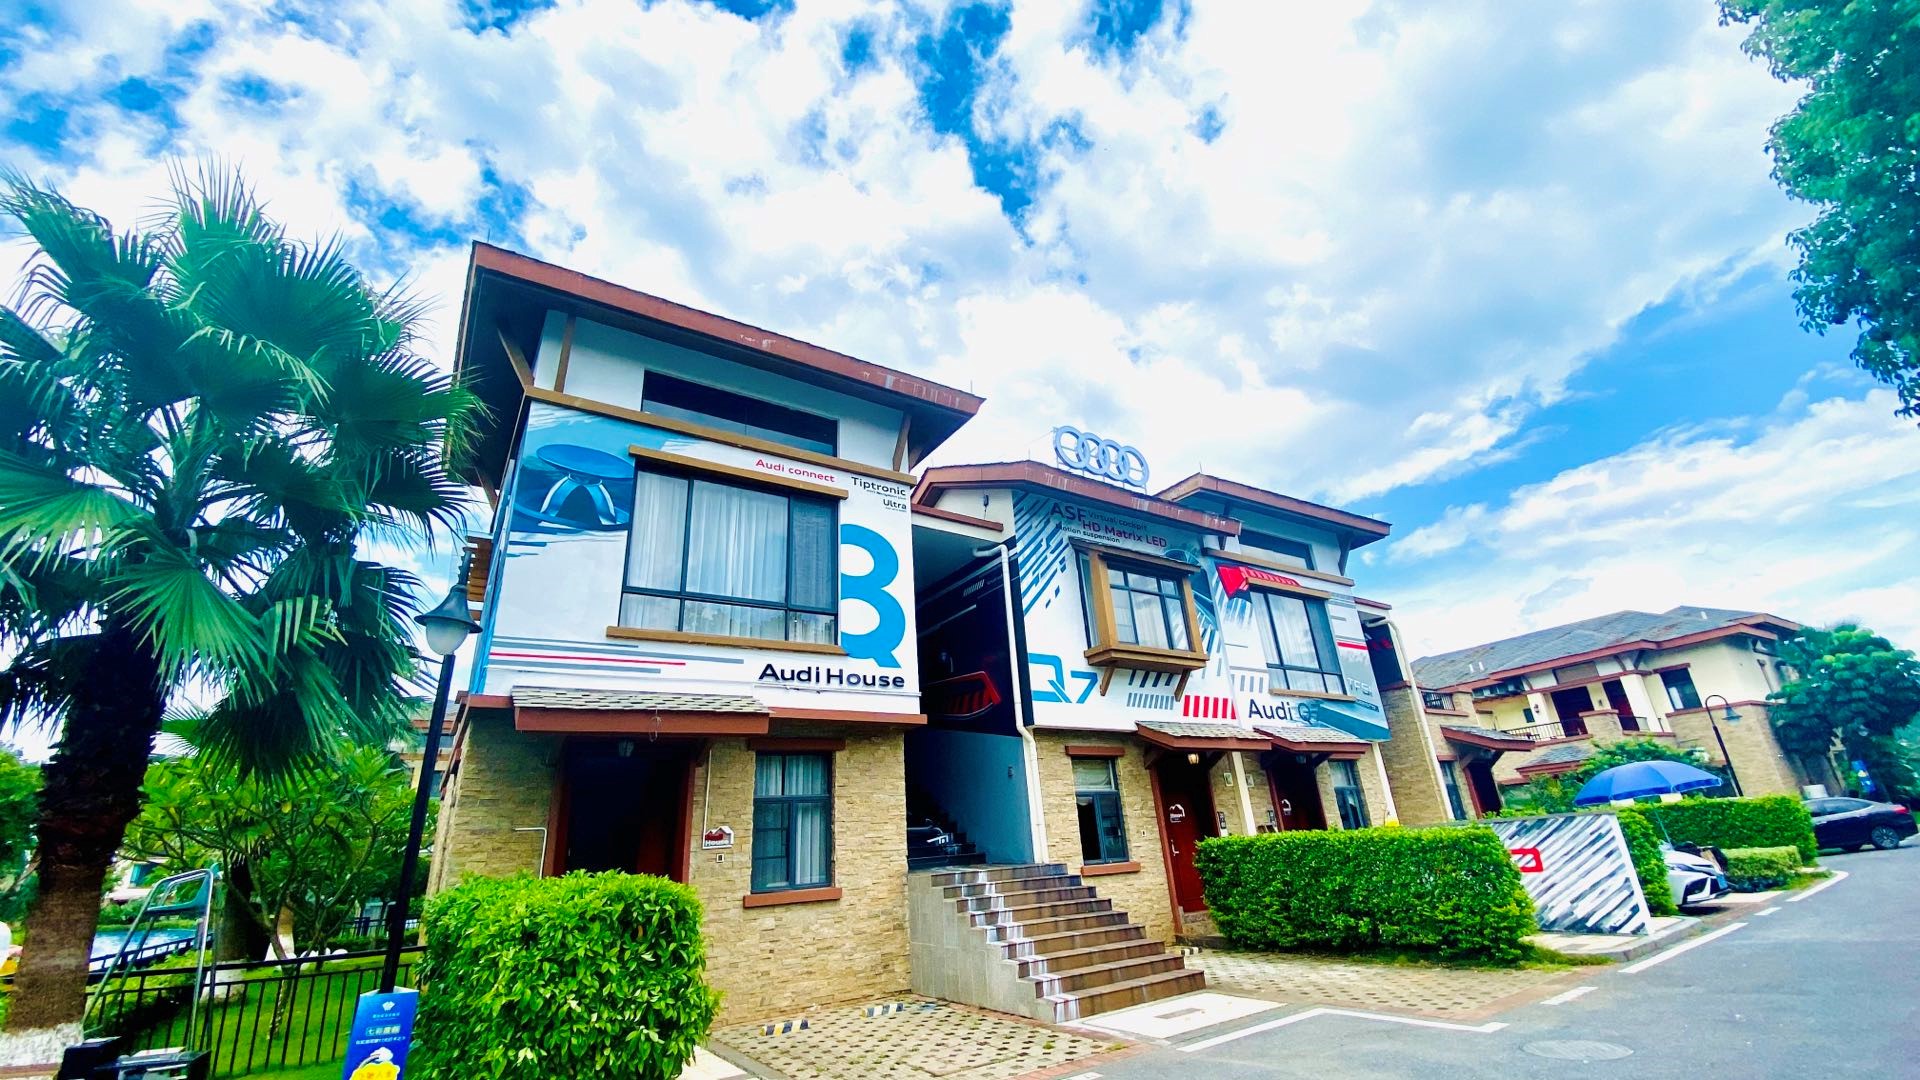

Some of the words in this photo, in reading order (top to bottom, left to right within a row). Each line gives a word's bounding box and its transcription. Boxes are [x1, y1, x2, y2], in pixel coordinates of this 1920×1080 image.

[756, 459, 785, 472] Audi
[788, 467, 836, 483] connect
[851, 476, 907, 497] Tiptronic
[883, 498, 907, 510] Ultra
[1050, 502, 1087, 522] ASF
[1082, 519, 1101, 533] HD
[1104, 524, 1142, 543] Matrix
[1145, 534, 1168, 548] LED
[758, 663, 821, 684] Audi
[826, 667, 906, 688] House
[1248, 698, 1293, 721] Audi
